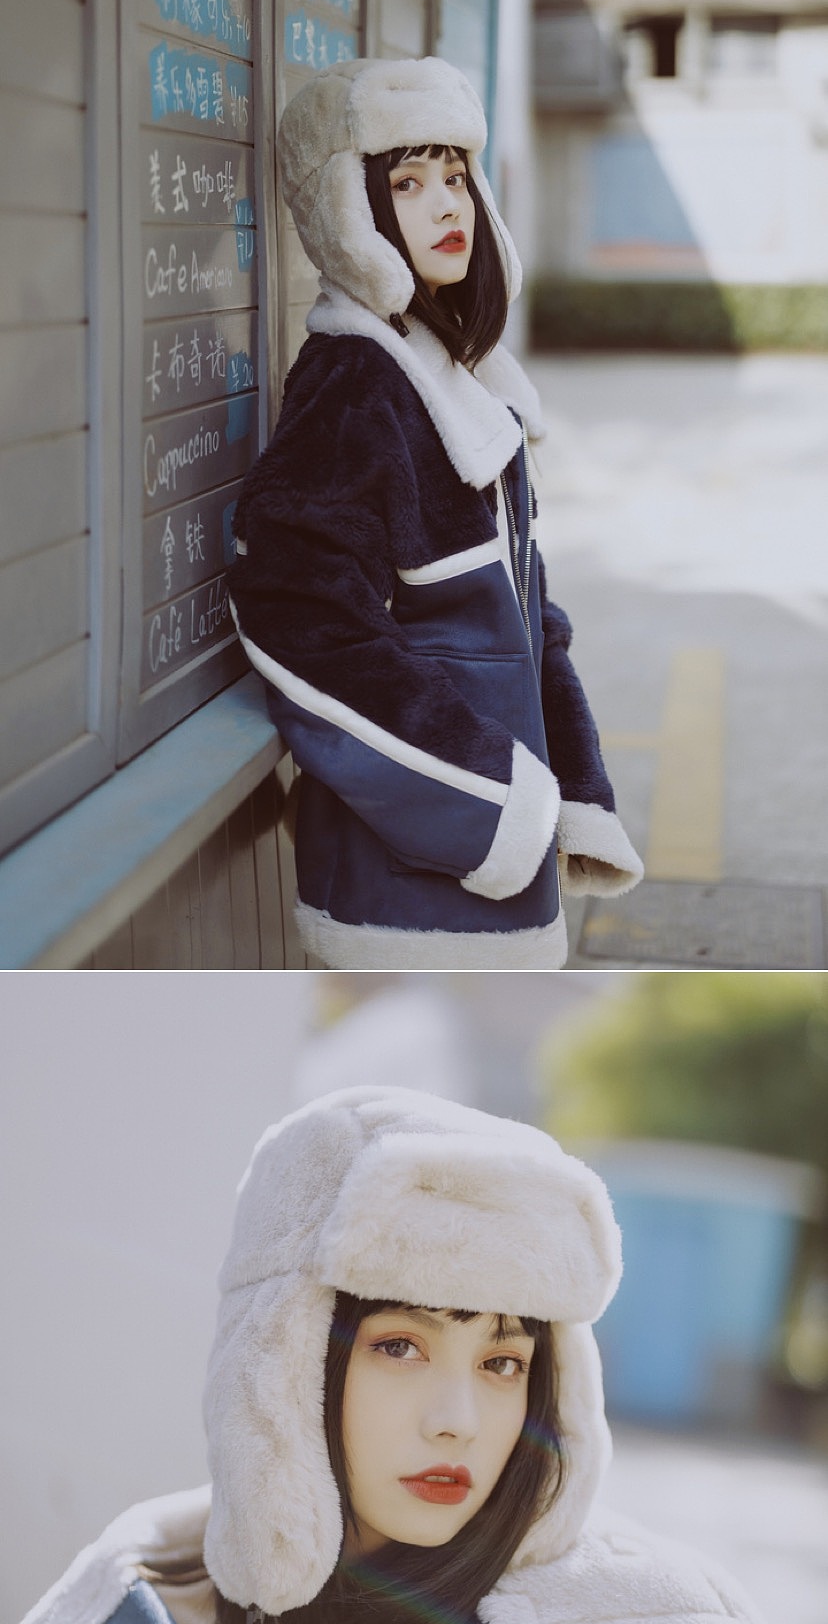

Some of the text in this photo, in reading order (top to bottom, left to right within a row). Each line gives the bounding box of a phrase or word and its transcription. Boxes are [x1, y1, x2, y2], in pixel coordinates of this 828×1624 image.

[154, 51, 225, 126] 养乐多雪碧
[150, 149, 236, 215] 美式咖啡
[145, 243, 188, 299] Cafe
[145, 328, 254, 402] 卡布奇诺 ¥20
[143, 425, 220, 498] Cappuccino
[160, 512, 206, 590] 拿铁
[150, 605, 184, 673] Café
